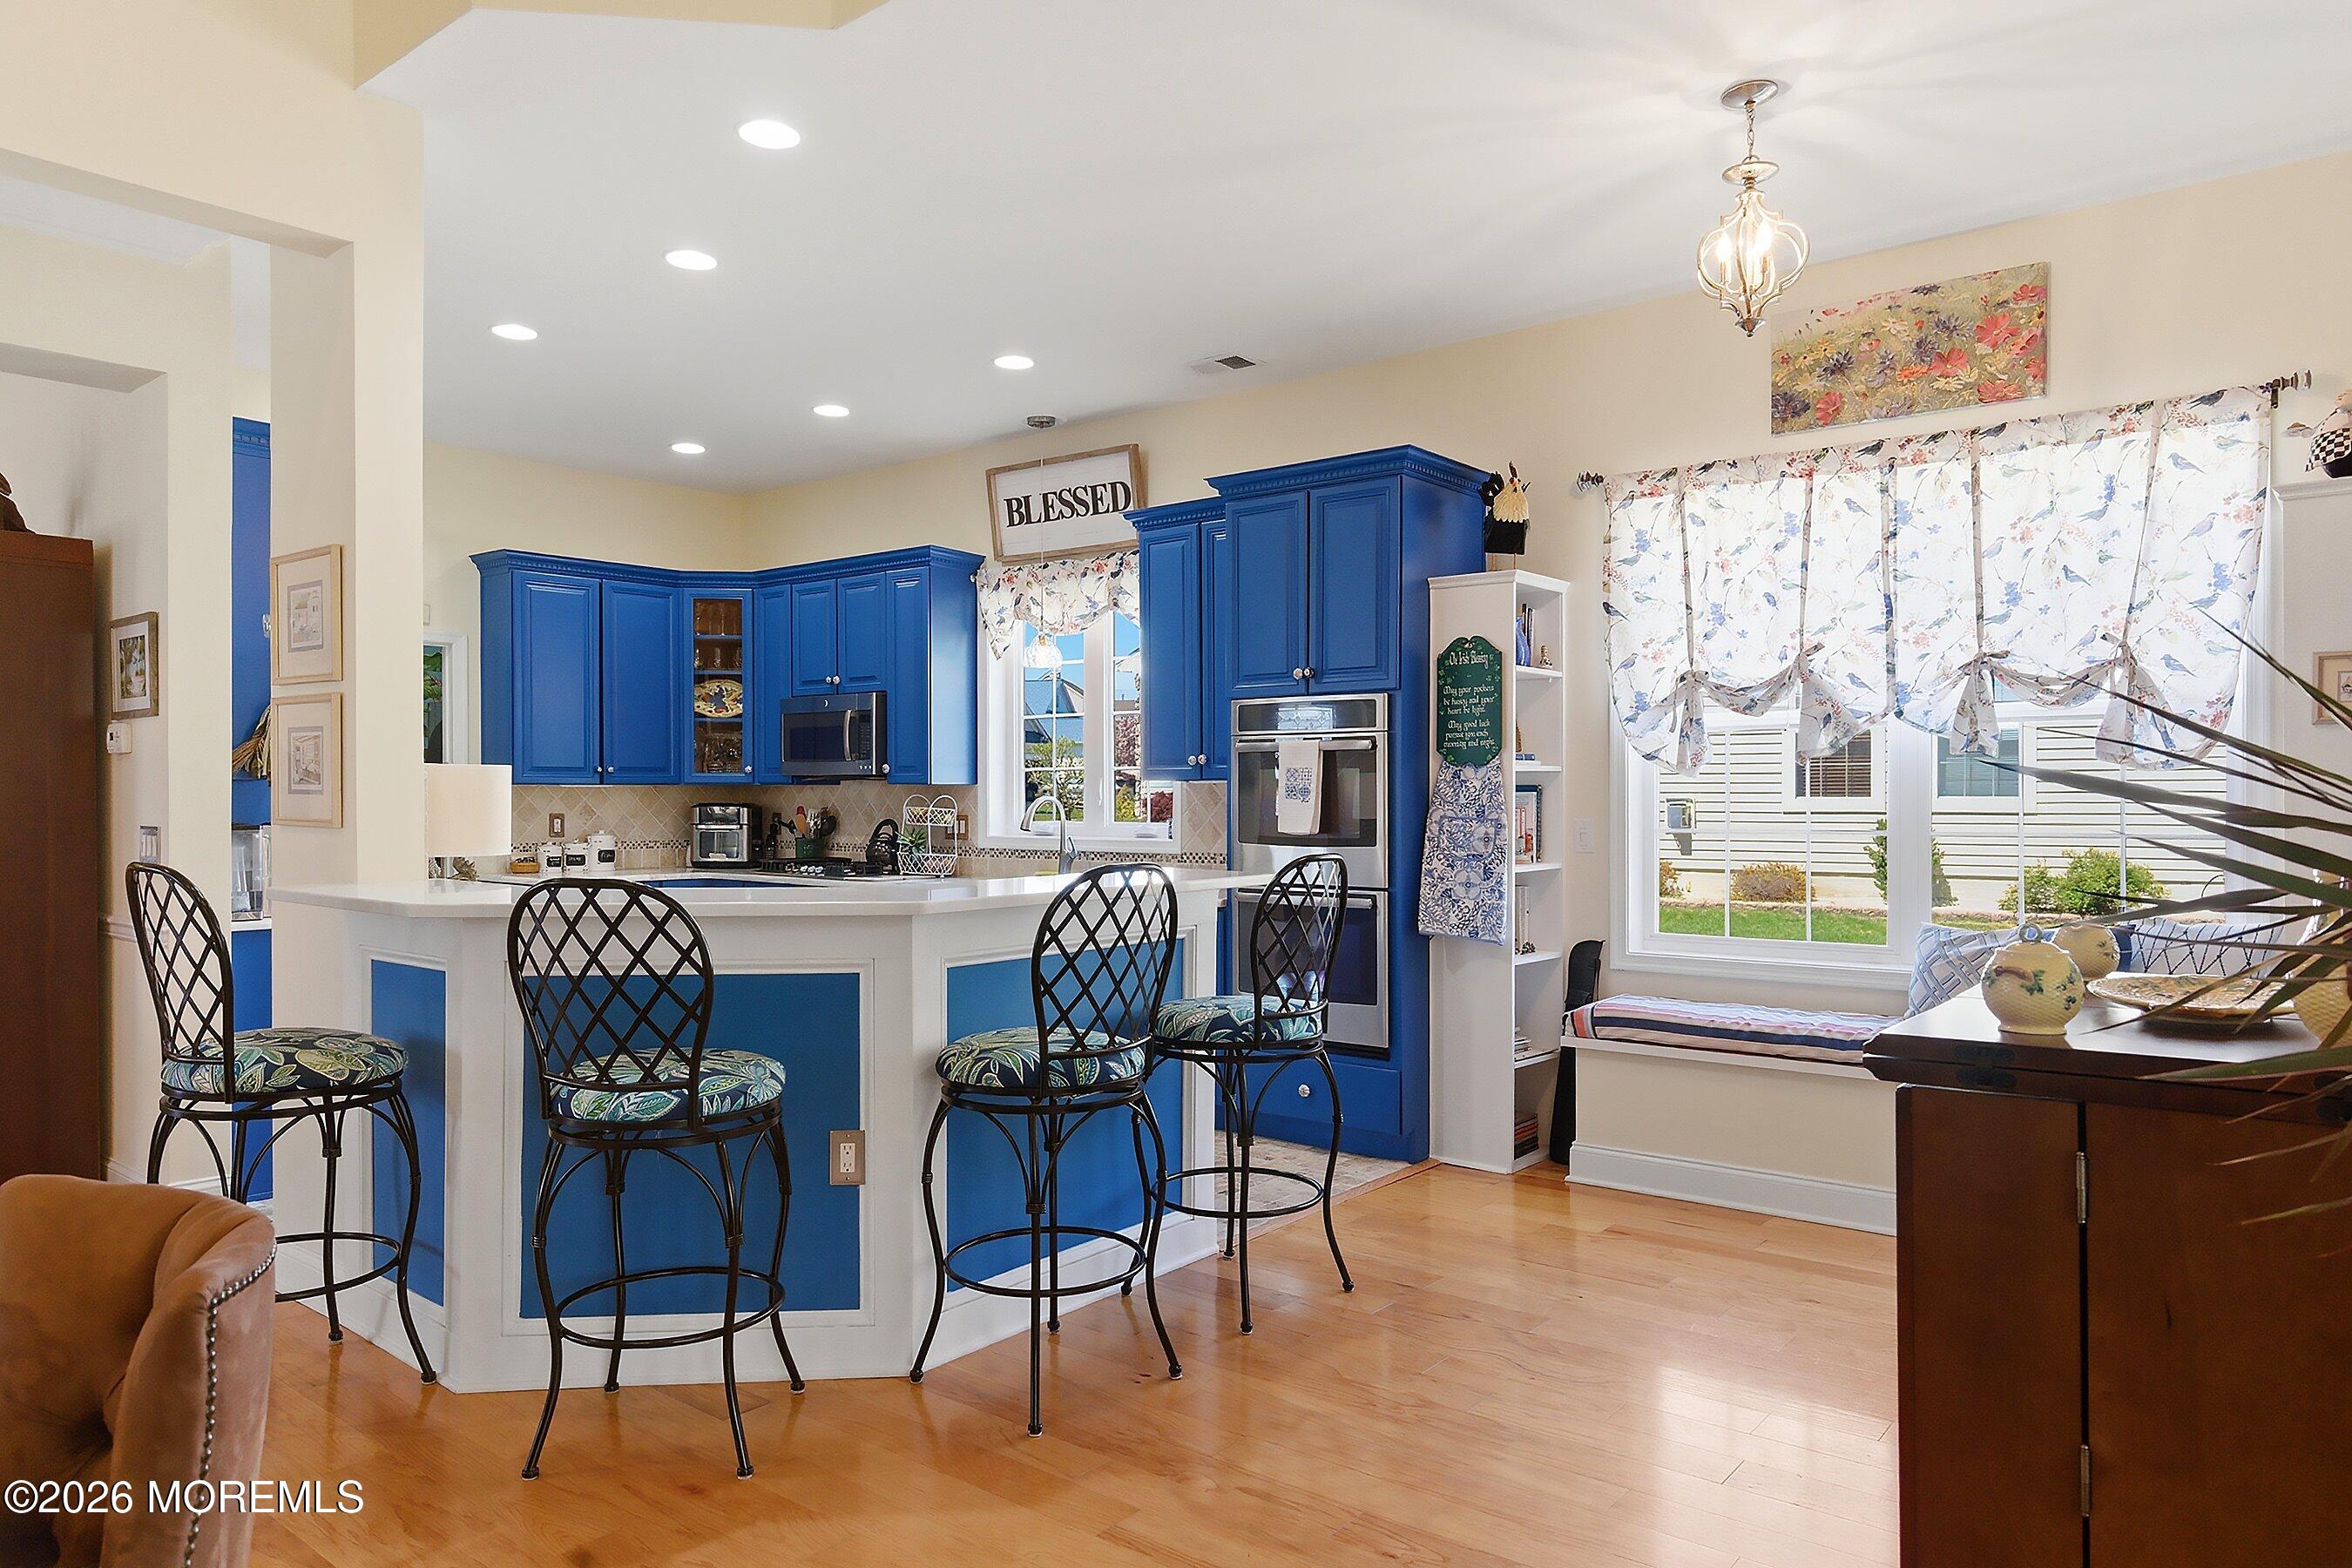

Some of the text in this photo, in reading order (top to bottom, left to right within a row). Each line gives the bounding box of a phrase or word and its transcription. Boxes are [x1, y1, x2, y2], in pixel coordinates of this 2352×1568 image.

[1004, 481, 1132, 528] BLESSED
[1458, 652, 1470, 665] Irish
[1470, 650, 1488, 669] Blessing
[1443, 684, 1495, 697] May your pockets
[1451, 698, 1468, 707] heavy
[1469, 695, 1479, 704] and
[1480, 697, 1495, 706] your
[1448, 719, 1490, 732] May good luck
[1465, 732, 1476, 740] you
[1443, 740, 1467, 749] morning
